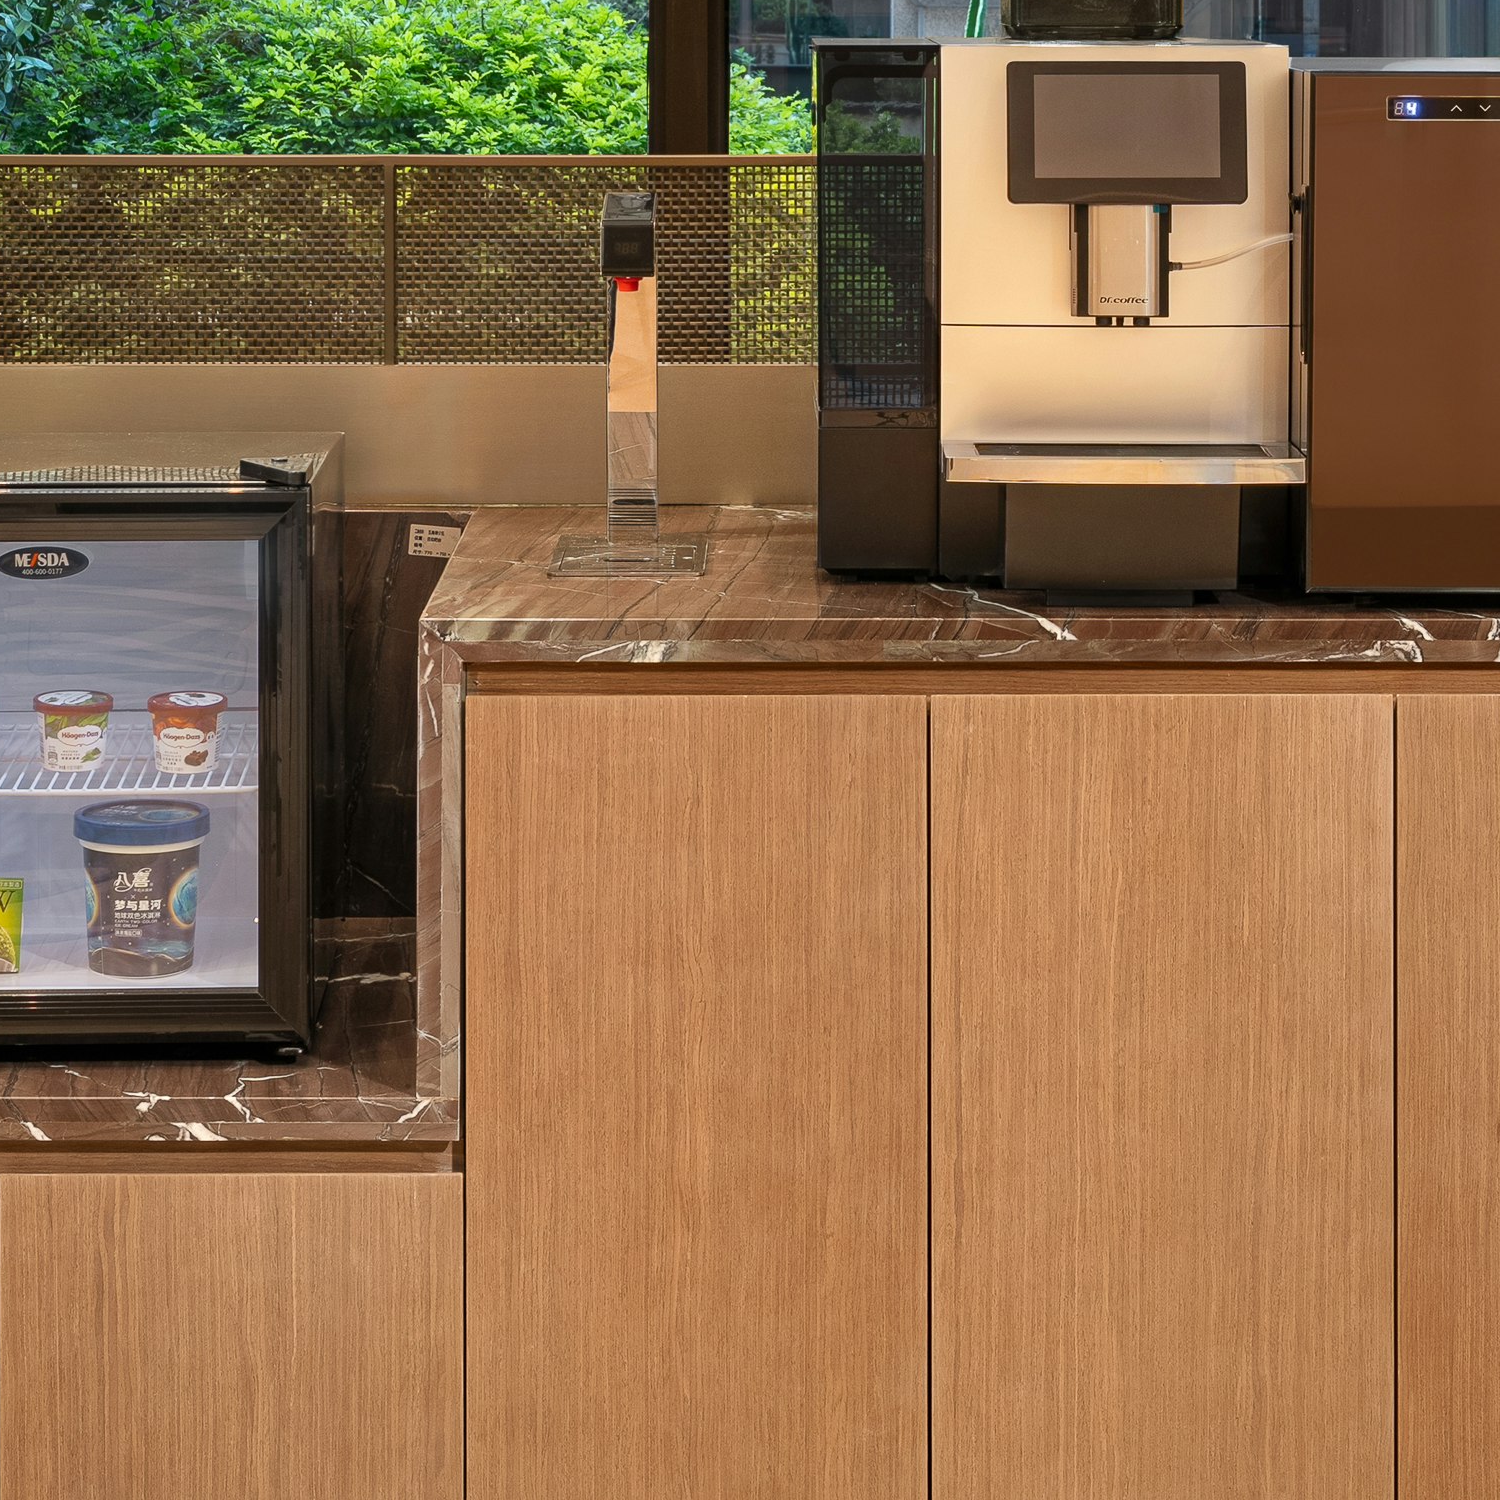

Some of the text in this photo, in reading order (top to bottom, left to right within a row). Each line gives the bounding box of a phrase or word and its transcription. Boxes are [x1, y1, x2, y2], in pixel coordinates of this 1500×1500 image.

[1099, 296, 1149, 304] Dr.coffee
[114, 899, 163, 911] 梦与星河
